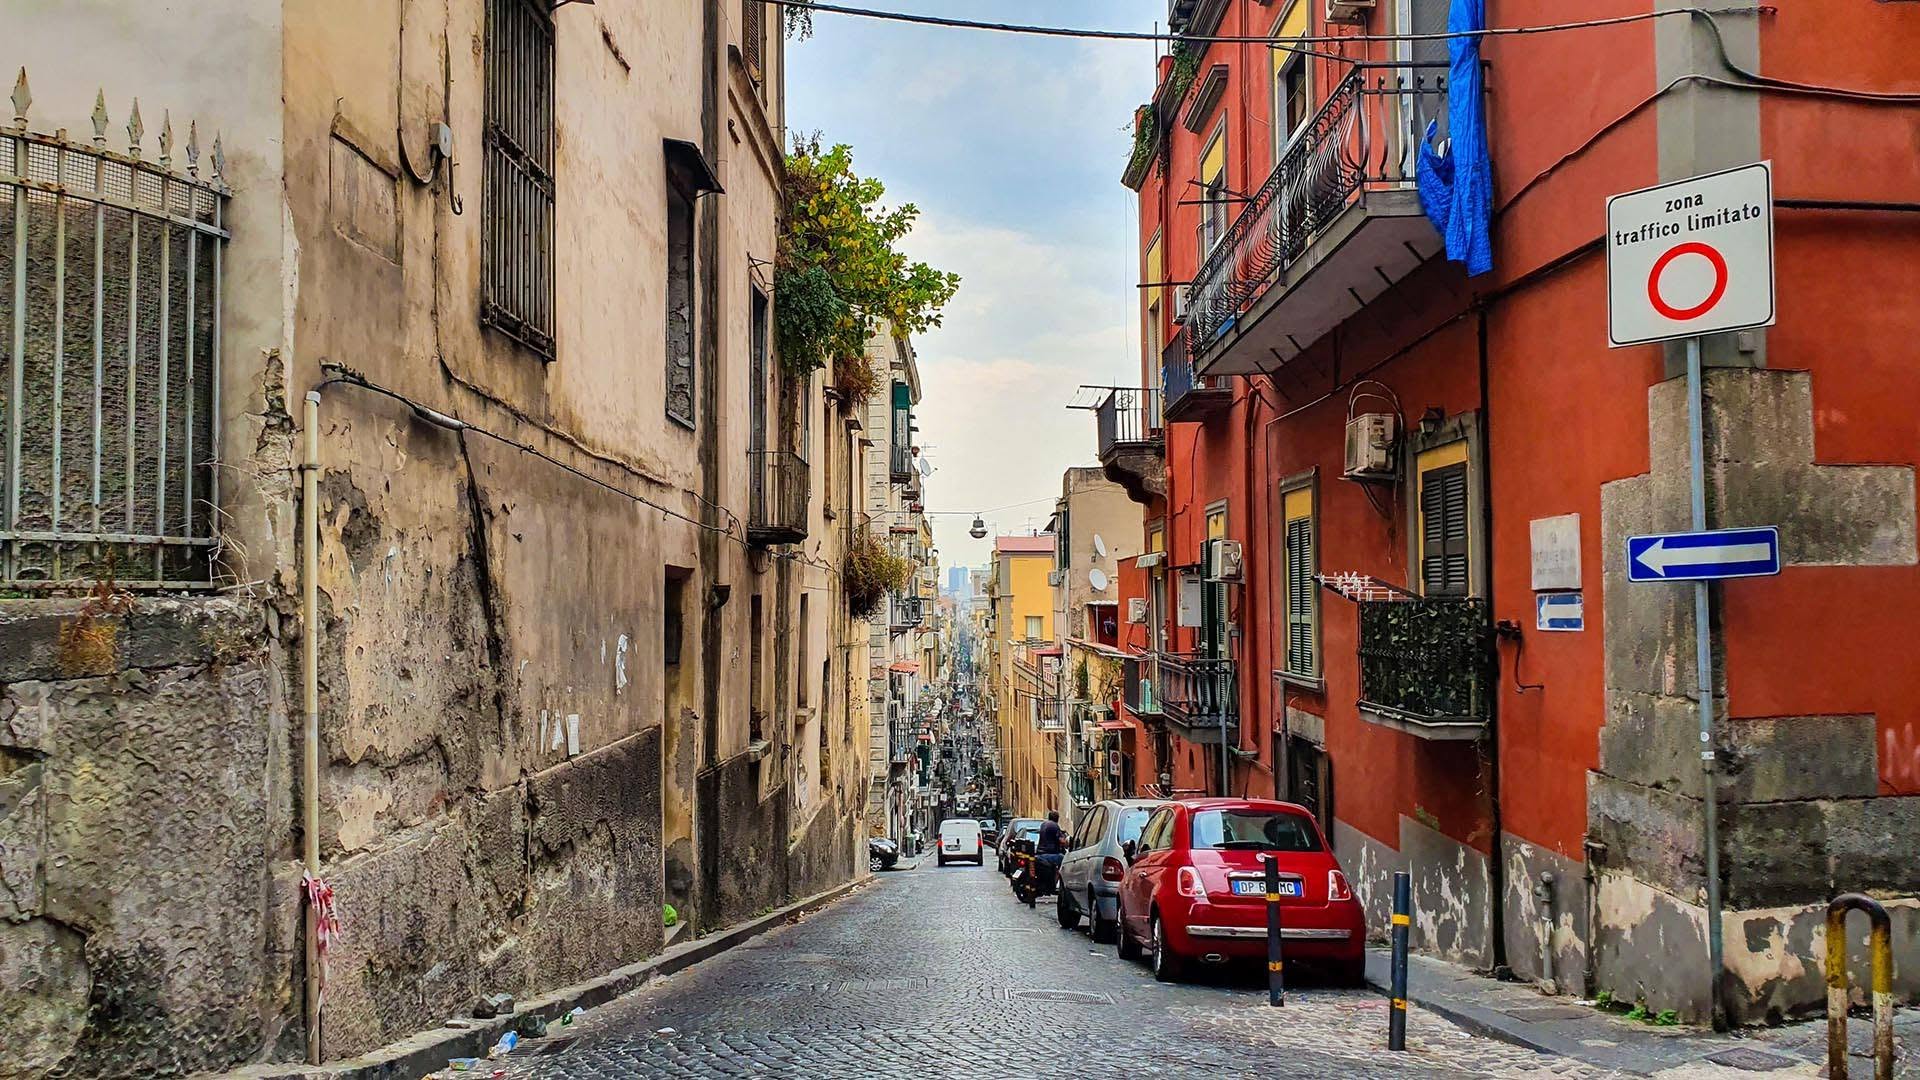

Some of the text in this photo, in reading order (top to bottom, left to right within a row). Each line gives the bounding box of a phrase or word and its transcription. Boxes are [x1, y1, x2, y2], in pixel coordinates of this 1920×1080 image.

[1665, 193, 1704, 213] zona
[1615, 203, 1761, 246] traffico limitato
[1240, 882, 1255, 893] DP
[1279, 882, 1294, 894] MC
